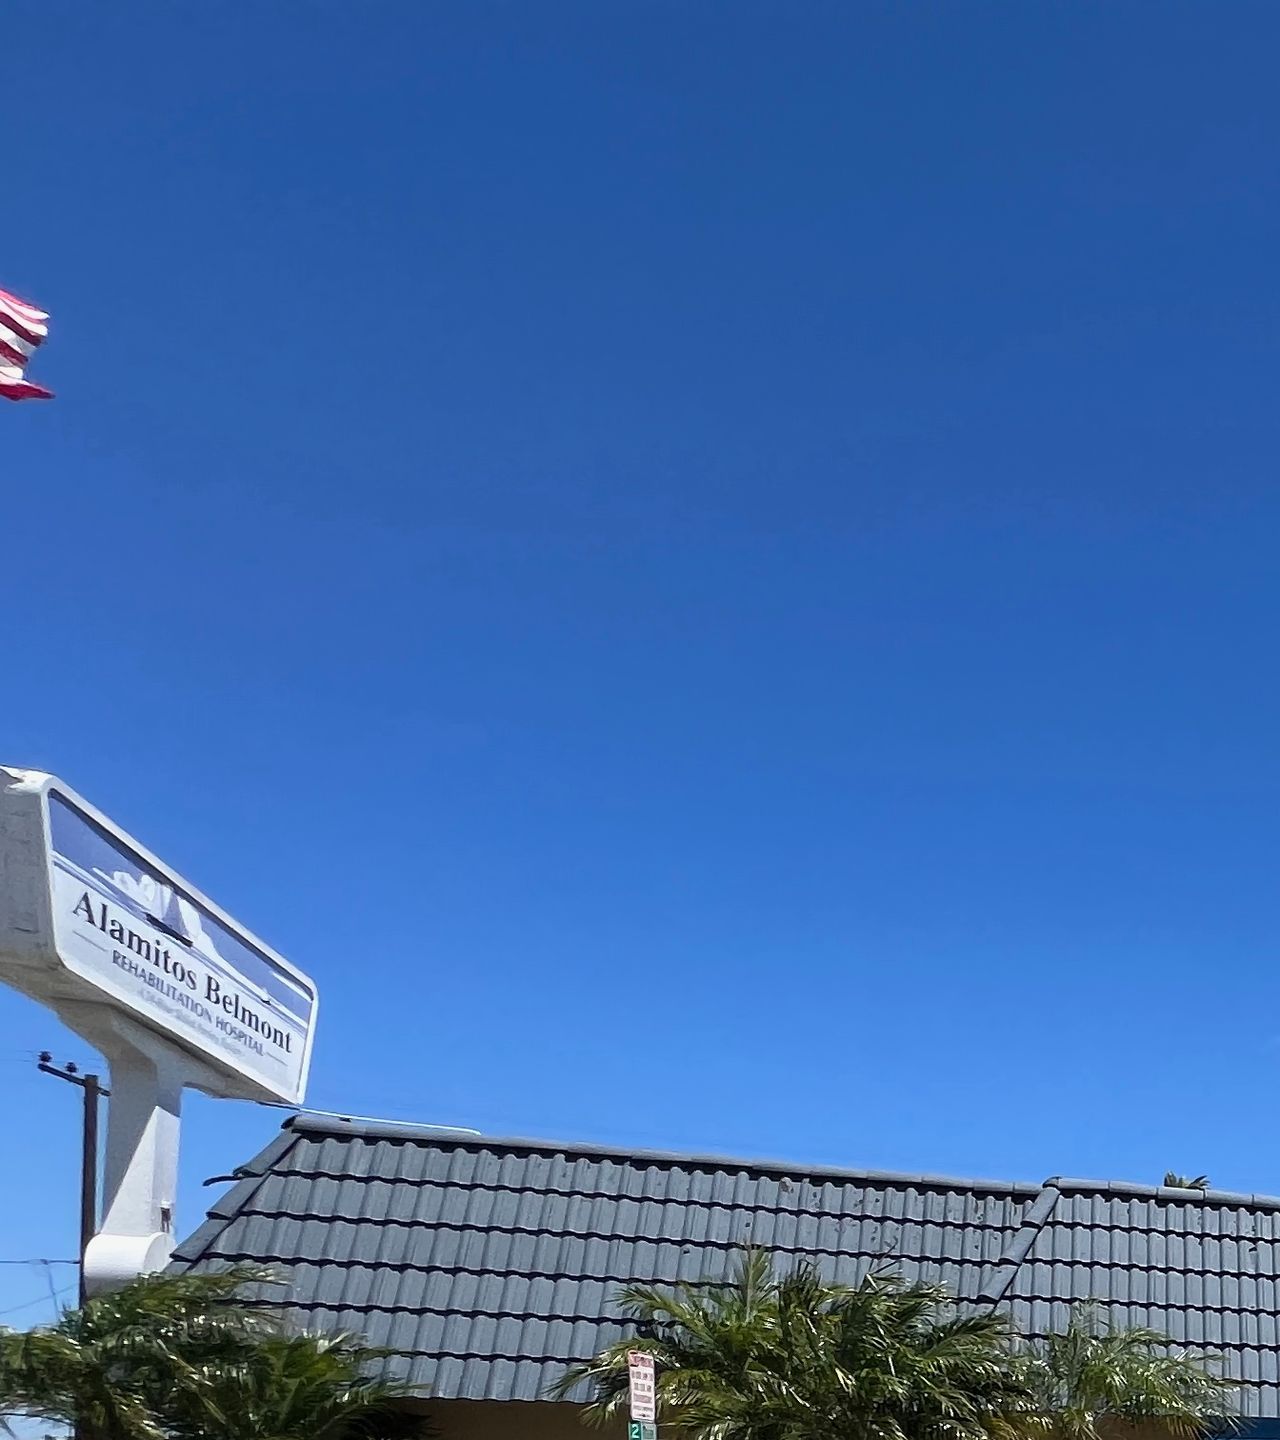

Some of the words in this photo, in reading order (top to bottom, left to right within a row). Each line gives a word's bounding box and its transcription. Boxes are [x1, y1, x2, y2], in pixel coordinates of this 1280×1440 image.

[72, 891, 197, 991] Alamitos
[205, 974, 293, 1053] Belmont
[112, 949, 213, 1023] REHABILITATION
[216, 1015, 264, 1057] HOSPITAL
[631, 1423, 640, 1439] 2
